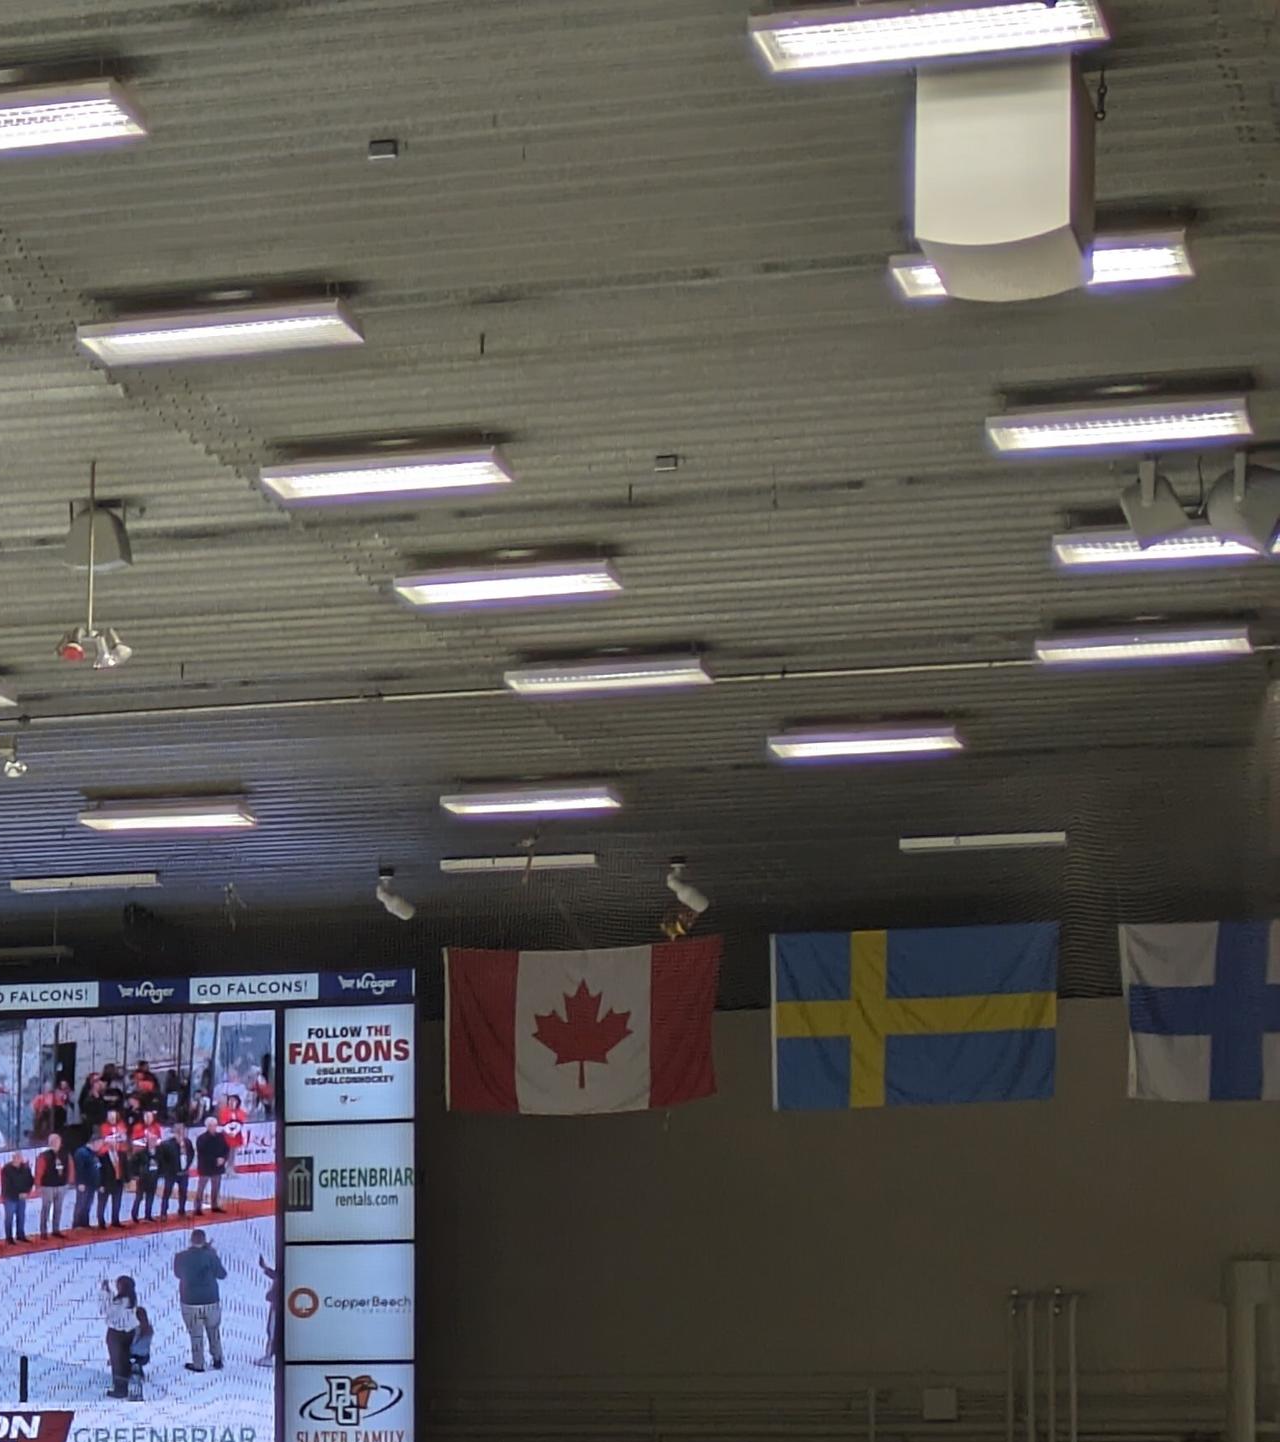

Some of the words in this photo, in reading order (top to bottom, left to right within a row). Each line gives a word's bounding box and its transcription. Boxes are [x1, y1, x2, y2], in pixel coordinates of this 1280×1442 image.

[10, 988, 88, 1002] FALCONS!
[197, 984, 222, 996] GO
[227, 980, 308, 995] FALCONS!
[307, 1026, 362, 1039] FOLLOW
[366, 1024, 392, 1037] THE
[288, 1038, 410, 1064] FALCONS
[318, 1167, 414, 1188] GREENBRIAR
[335, 1190, 399, 1206] rentals.com
